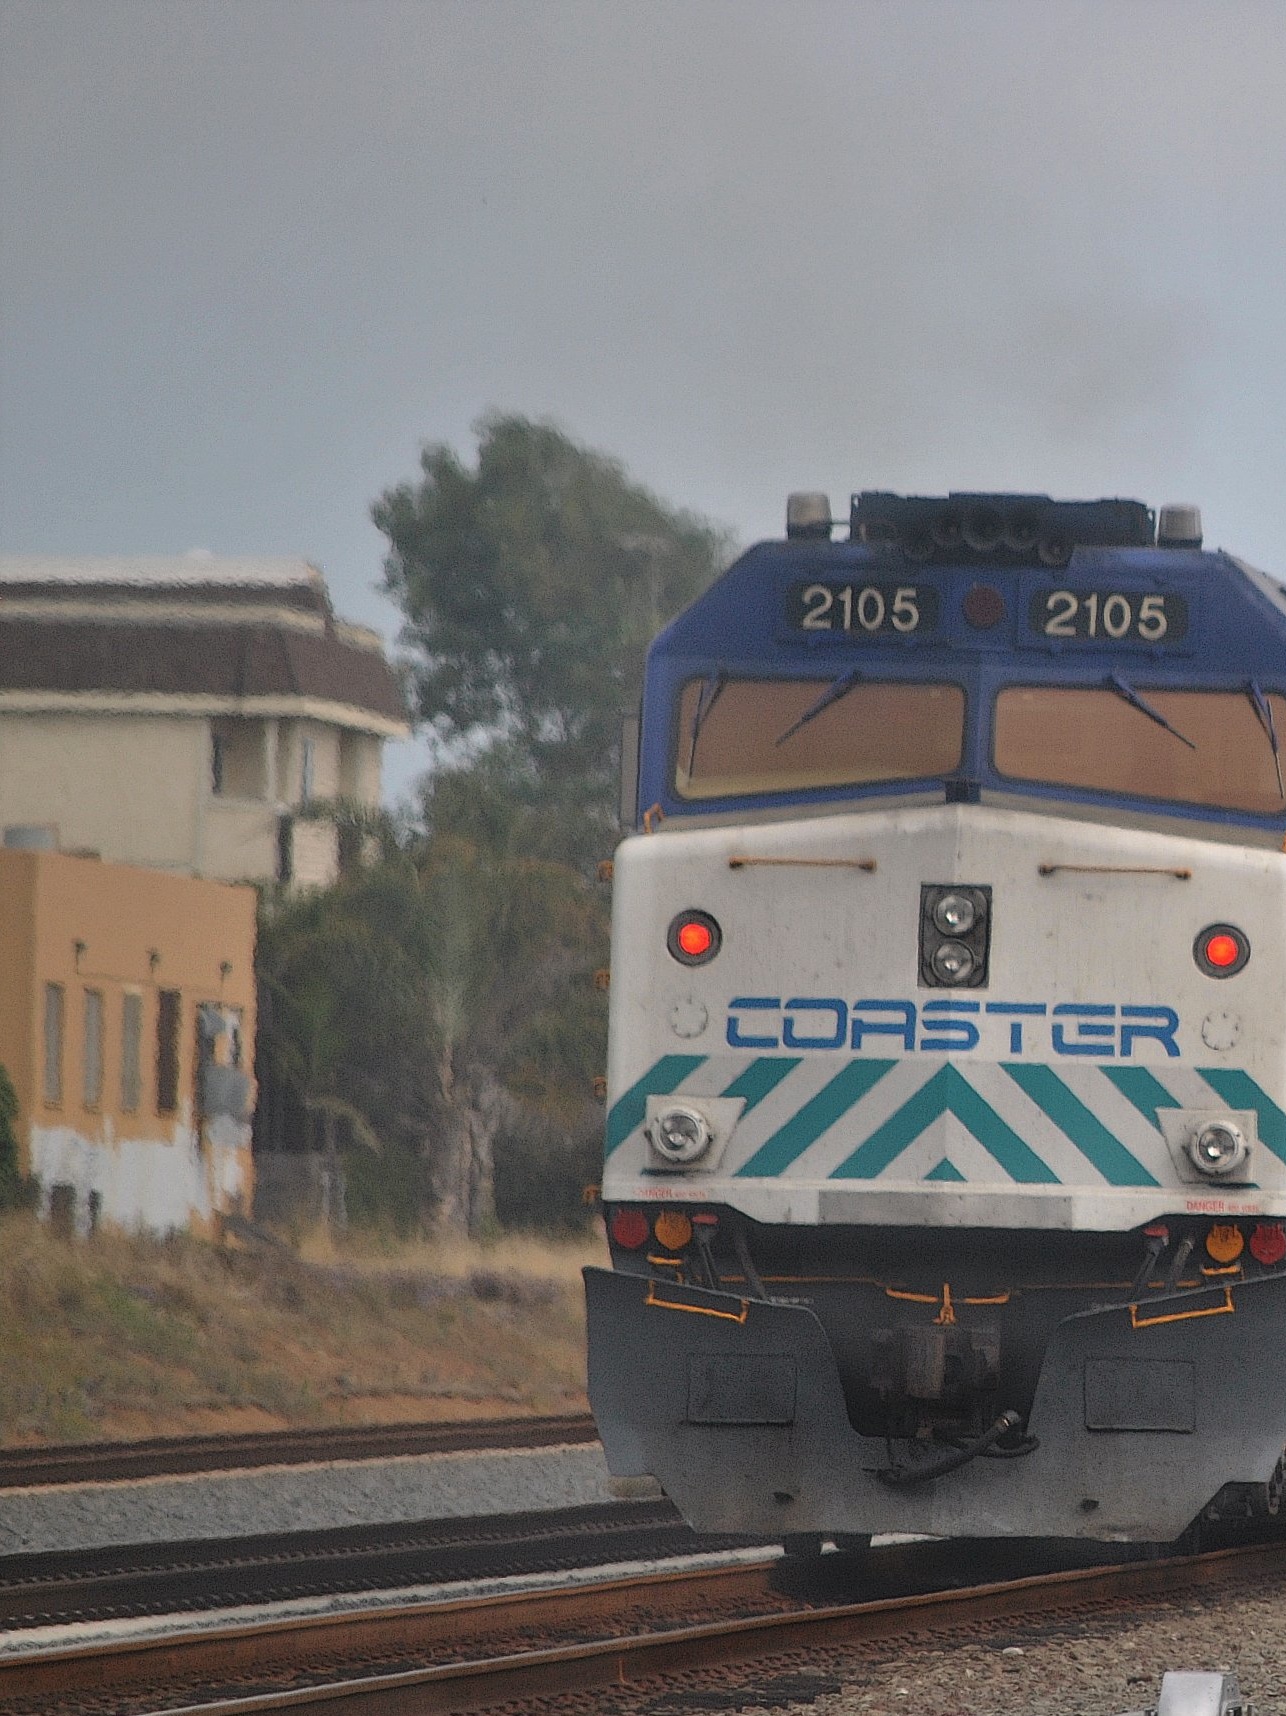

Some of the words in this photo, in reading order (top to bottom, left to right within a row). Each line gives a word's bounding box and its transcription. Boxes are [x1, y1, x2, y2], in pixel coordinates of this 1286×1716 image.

[803, 584, 919, 632] 2105
[1045, 591, 1168, 640] 2105
[726, 997, 1181, 1057] COASTER
